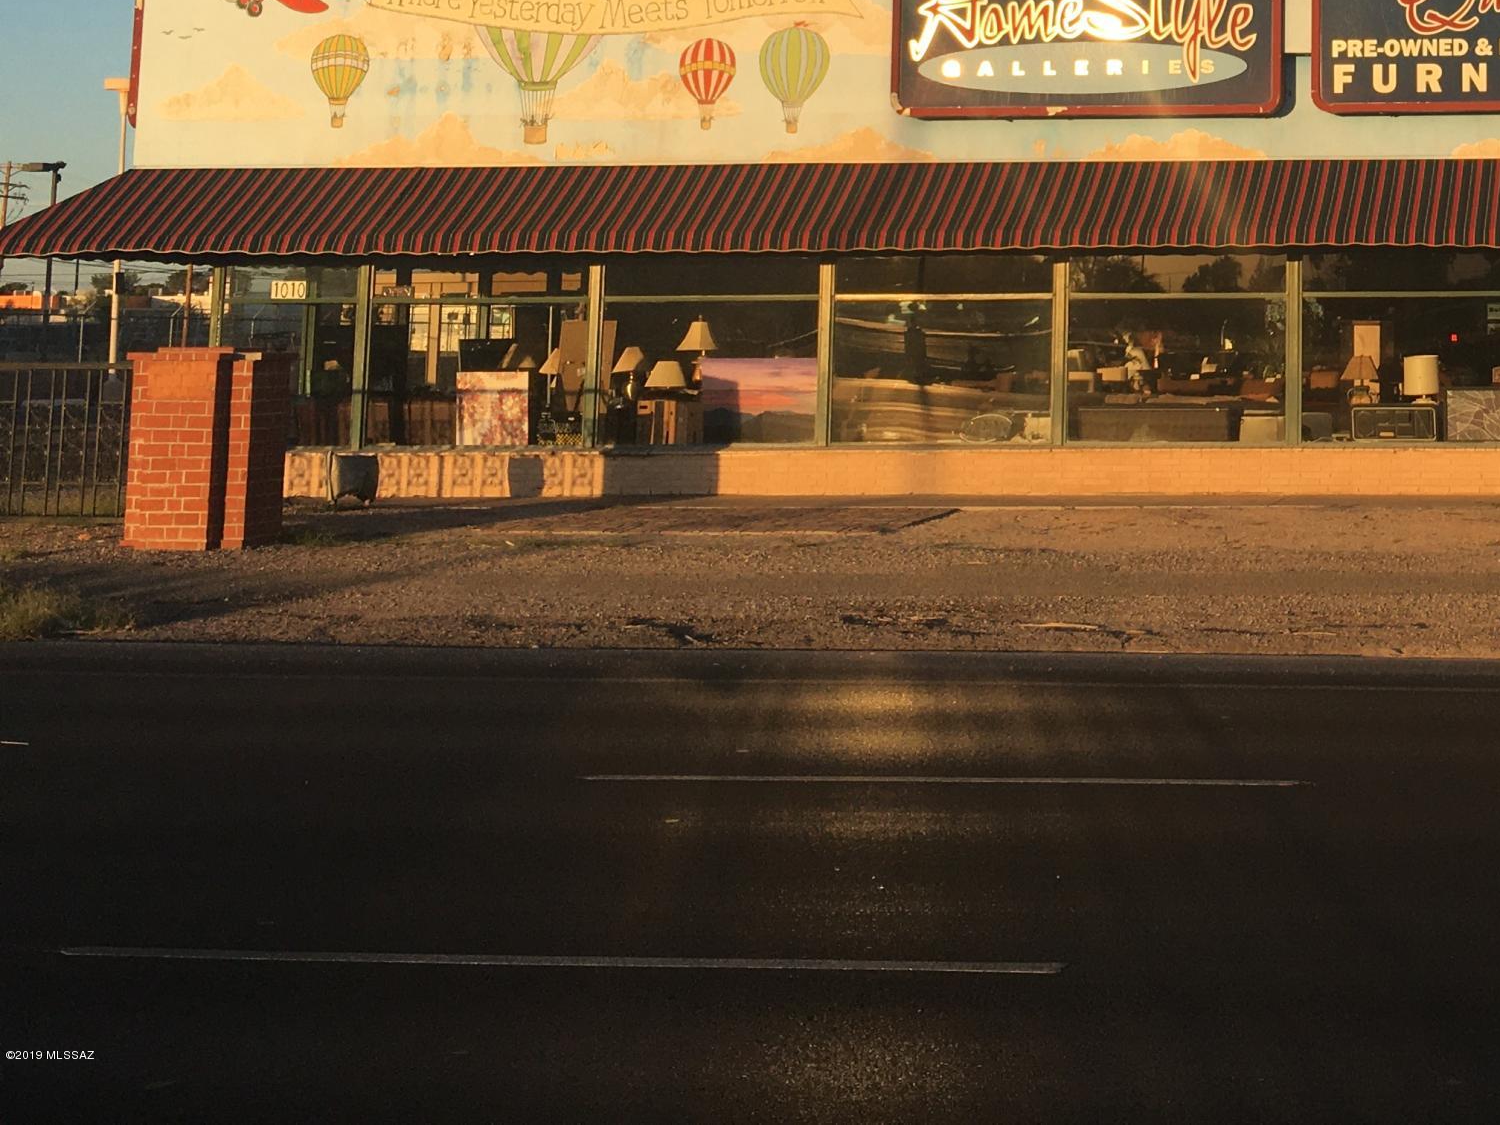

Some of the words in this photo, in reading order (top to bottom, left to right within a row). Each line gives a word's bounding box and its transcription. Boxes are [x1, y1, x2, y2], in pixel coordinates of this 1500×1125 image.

[1331, 38, 1469, 58] PRE-OWNED
[1475, 37, 1494, 57] &
[274, 282, 306, 298] 1010
